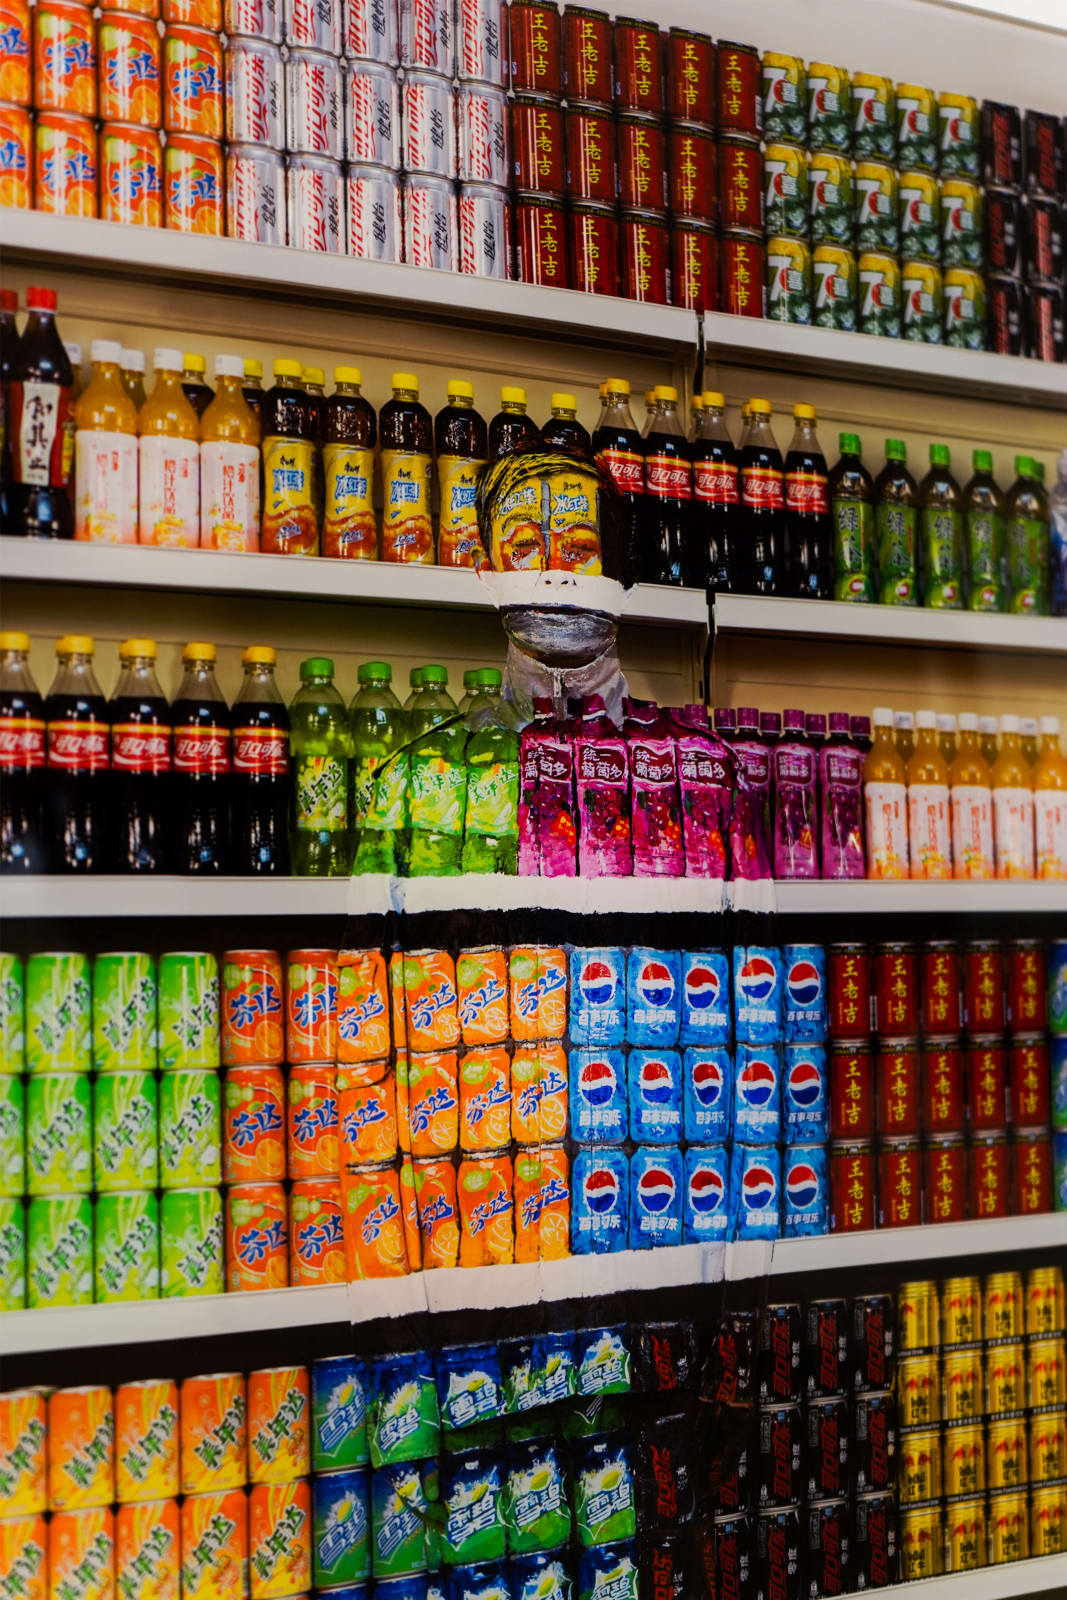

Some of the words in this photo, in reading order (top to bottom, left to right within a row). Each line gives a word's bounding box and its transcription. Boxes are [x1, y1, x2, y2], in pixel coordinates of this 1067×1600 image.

[531, 13, 548, 76] 王老吉
[580, 23, 598, 84] 王老吉
[634, 34, 651, 96] 王老吉
[682, 44, 699, 104] 王老吉
[726, 56, 741, 115] 王老吉
[377, 101, 390, 141] 健怡
[431, 109, 443, 149] 健怡
[536, 113, 552, 176] 王老吉
[585, 122, 602, 184] 王老吉
[633, 131, 650, 192] 王老吉
[681, 140, 696, 201] 王老吉
[732, 152, 748, 211] 王老吉
[373, 203, 385, 243] 健怡
[484, 220, 494, 260] 健怡
[540, 213, 558, 276] 王老吉
[583, 220, 600, 282] 王老吉
[636, 229, 651, 291] 王老吉
[686, 237, 700, 298] 王老吉
[733, 246, 750, 306] 王老吉
[651, 468, 689, 484] 可口可乐
[698, 473, 734, 490] 可口可乐
[746, 479, 780, 495] 可口可乐
[239, 741, 283, 757] 可口可乐
[581, 761, 622, 779] 葡萄多
[582, 748, 611, 761] 统一
[635, 751, 658, 762] 统一
[635, 762, 672, 780] 葡萄多
[682, 761, 725, 779] 葡萄多
[230, 984, 282, 1028] 芬达
[294, 984, 338, 1027] 芬达
[411, 984, 456, 1031] 芬达
[461, 980, 505, 1026] 芬达
[518, 969, 567, 1016] 芬达
[842, 958, 858, 1023] 王老吉
[891, 958, 907, 1022] 王老吉
[933, 957, 948, 1020] 王老吉
[979, 956, 994, 1019] 王老吉
[1022, 956, 1036, 1018] 王老吉
[339, 992, 385, 1039] 芬达
[788, 1010, 821, 1022] 百事可乐
[466, 1081, 512, 1125] 芬达
[518, 1072, 568, 1117] 芬达
[845, 1060, 861, 1124] 王老吉
[892, 1058, 907, 1121] 王老吉
[935, 1055, 950, 1118] 王老吉
[980, 1054, 995, 1116] 王老吉
[1024, 1052, 1038, 1113] 王老吉
[232, 1102, 283, 1146] 芬达
[293, 1099, 338, 1143] 芬达
[410, 1087, 456, 1135] 芬达
[788, 1111, 822, 1123] 百事可乐
[848, 1160, 864, 1224] 王老吉
[896, 1156, 911, 1220] 王老吉
[937, 1154, 952, 1216] 王老吉
[982, 1150, 996, 1213] 王老吉
[1025, 1147, 1040, 1209] 王老吉
[362, 1194, 400, 1245] 芬达
[471, 1191, 512, 1238] 芬达
[523, 1180, 569, 1228] 芬达
[785, 1213, 819, 1225] 百事可乐
[240, 1220, 287, 1264] 芬达
[298, 1215, 343, 1259] 芬达
[581, 1360, 622, 1394] 雪碧
[252, 1386, 306, 1464] 美年达
[320, 1390, 366, 1451] 雪碧
[380, 1408, 420, 1450] 雪碧
[449, 1381, 498, 1428] 雪碧
[194, 1394, 245, 1471] 美年达
[448, 1493, 497, 1544] 雪碧
[516, 1483, 561, 1526] 雪碧
[586, 1483, 631, 1526] 雪碧
[253, 1504, 306, 1582] 美年达
[317, 1506, 368, 1568] 雪碧
